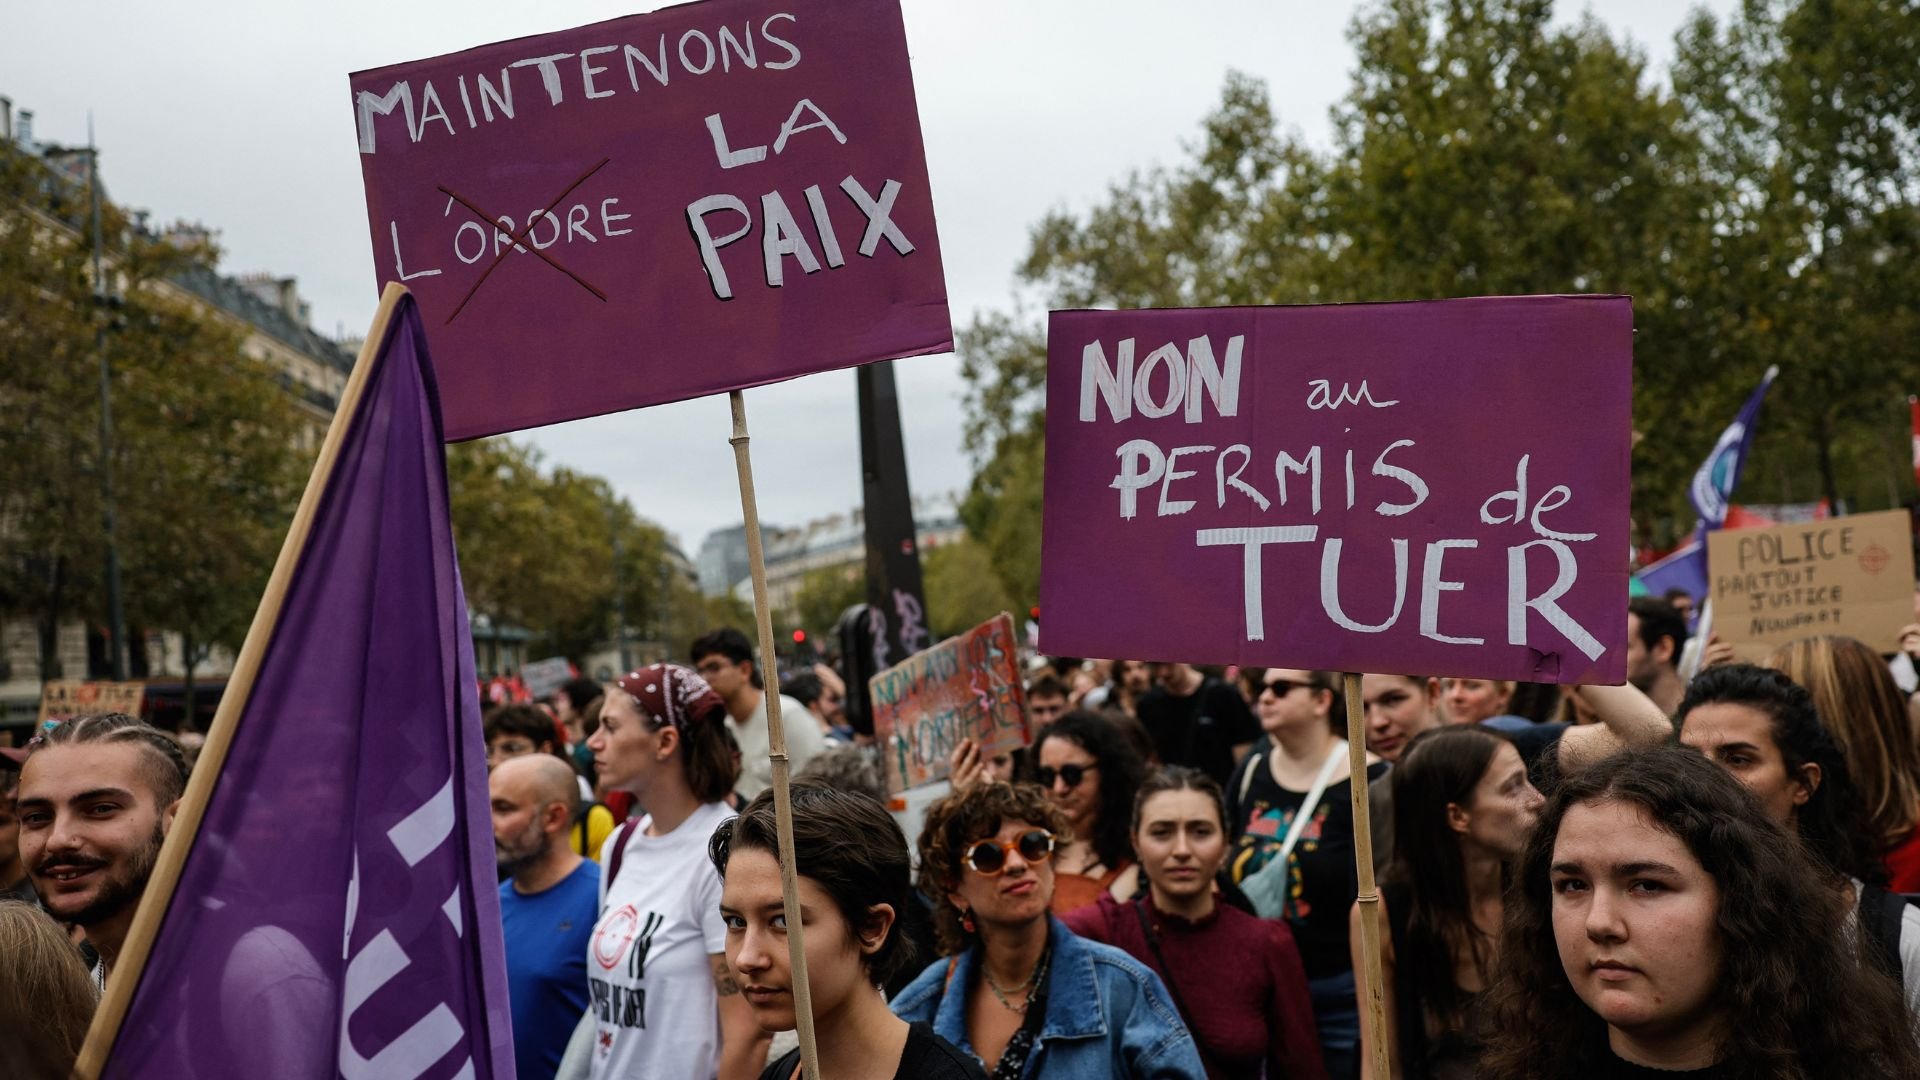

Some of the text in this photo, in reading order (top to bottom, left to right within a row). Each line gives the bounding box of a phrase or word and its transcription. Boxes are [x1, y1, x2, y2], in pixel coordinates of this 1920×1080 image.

[357, 13, 801, 154] MAINTENONS
[704, 98, 848, 169] LA
[686, 174, 916, 300] PAIX
[1079, 334, 1400, 424] NON au
[1479, 454, 1598, 542] de
[1717, 566, 1815, 598] PARTOUT
[1738, 527, 1855, 570] POLICE
[1196, 525, 1607, 662] TUER
[1749, 585, 1842, 612] JUSTICE
